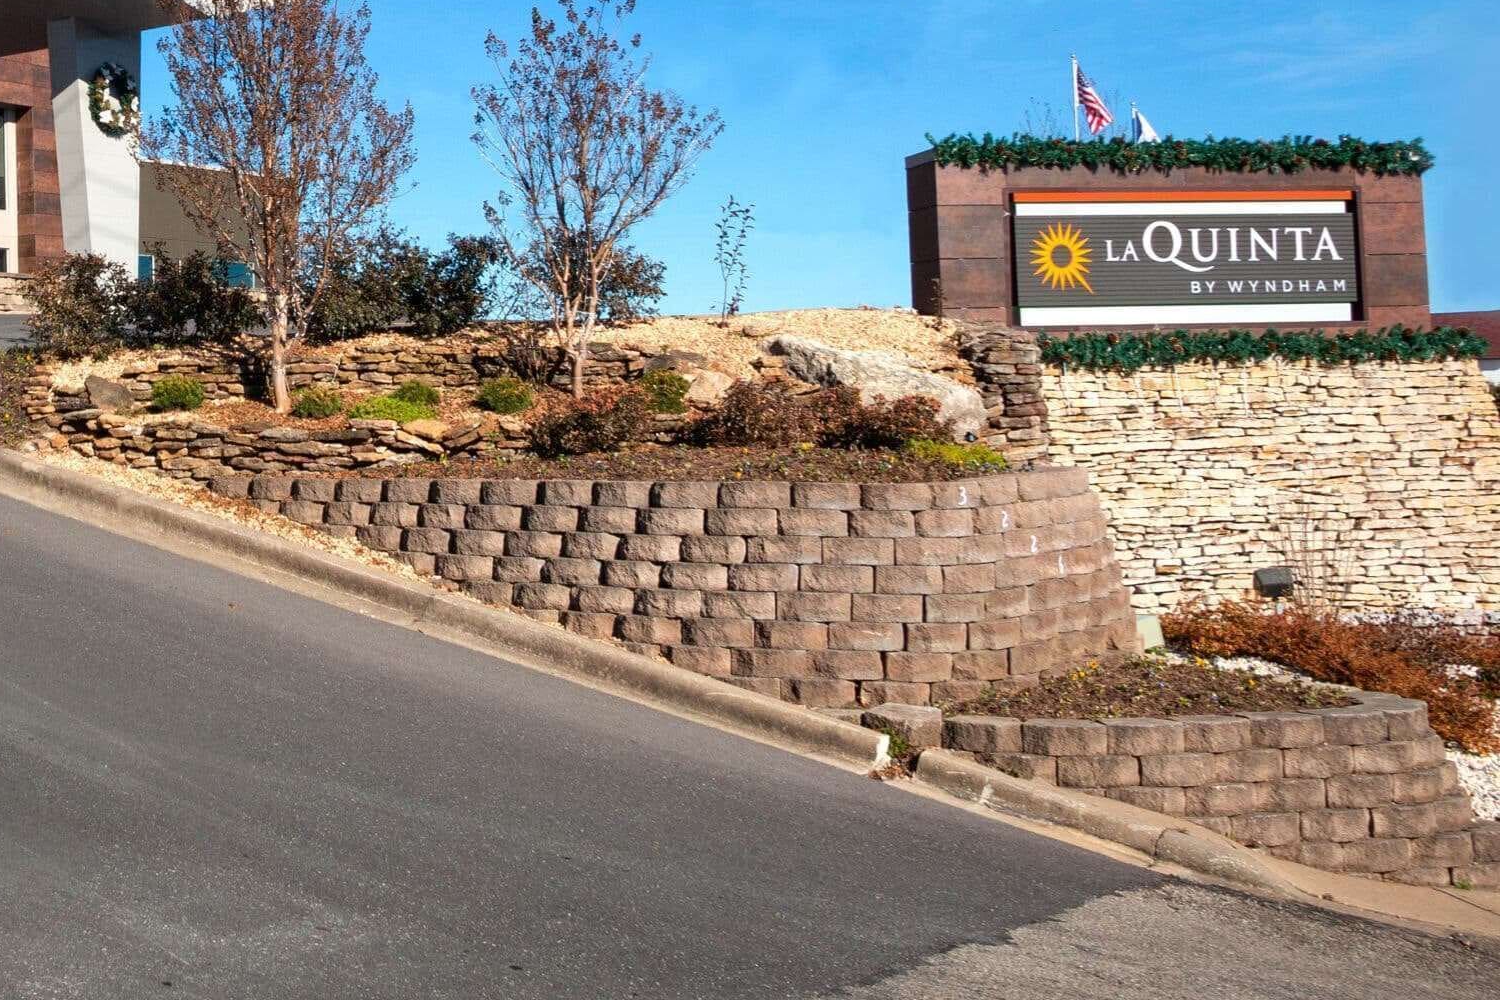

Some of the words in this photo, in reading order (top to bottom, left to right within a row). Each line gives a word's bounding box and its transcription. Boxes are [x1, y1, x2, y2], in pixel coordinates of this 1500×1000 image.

[1105, 239, 1139, 262] LA
[1142, 220, 1343, 272] QUINTA
[1191, 281, 1216, 293] BY
[1228, 279, 1346, 293] WYNDHAM
